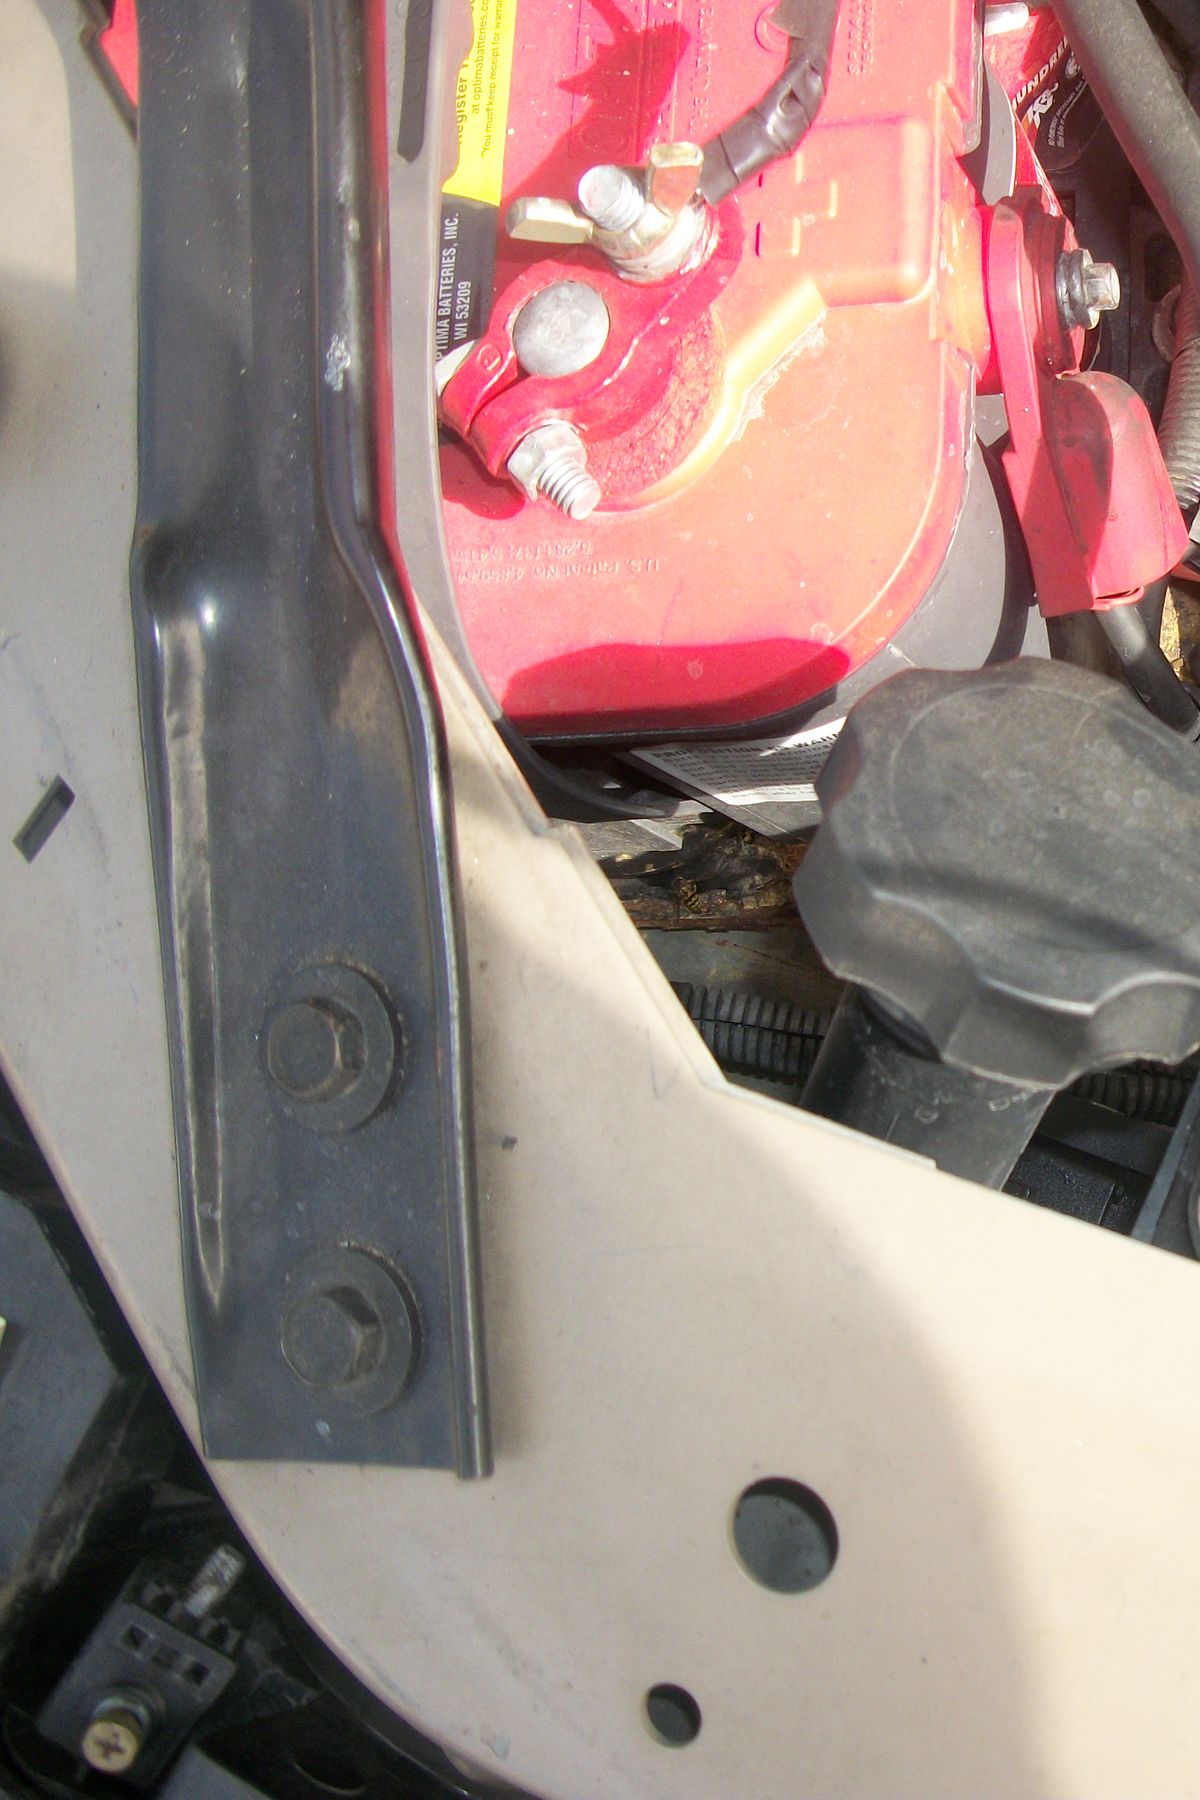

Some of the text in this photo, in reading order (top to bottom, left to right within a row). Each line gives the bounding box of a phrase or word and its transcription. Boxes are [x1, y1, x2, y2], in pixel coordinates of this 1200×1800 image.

[489, 45, 500, 80] receipt
[491, 30, 500, 45] for
[847, 0, 861, 76] SPIRAL
[861, 0, 875, 74] TECHNO
[456, 77, 467, 145] egister
[472, 102, 480, 115] at
[486, 81, 497, 106] keep
[435, 212, 459, 362] PTIMA BATTERIES, INC.
[453, 281, 472, 341] WI 53209
